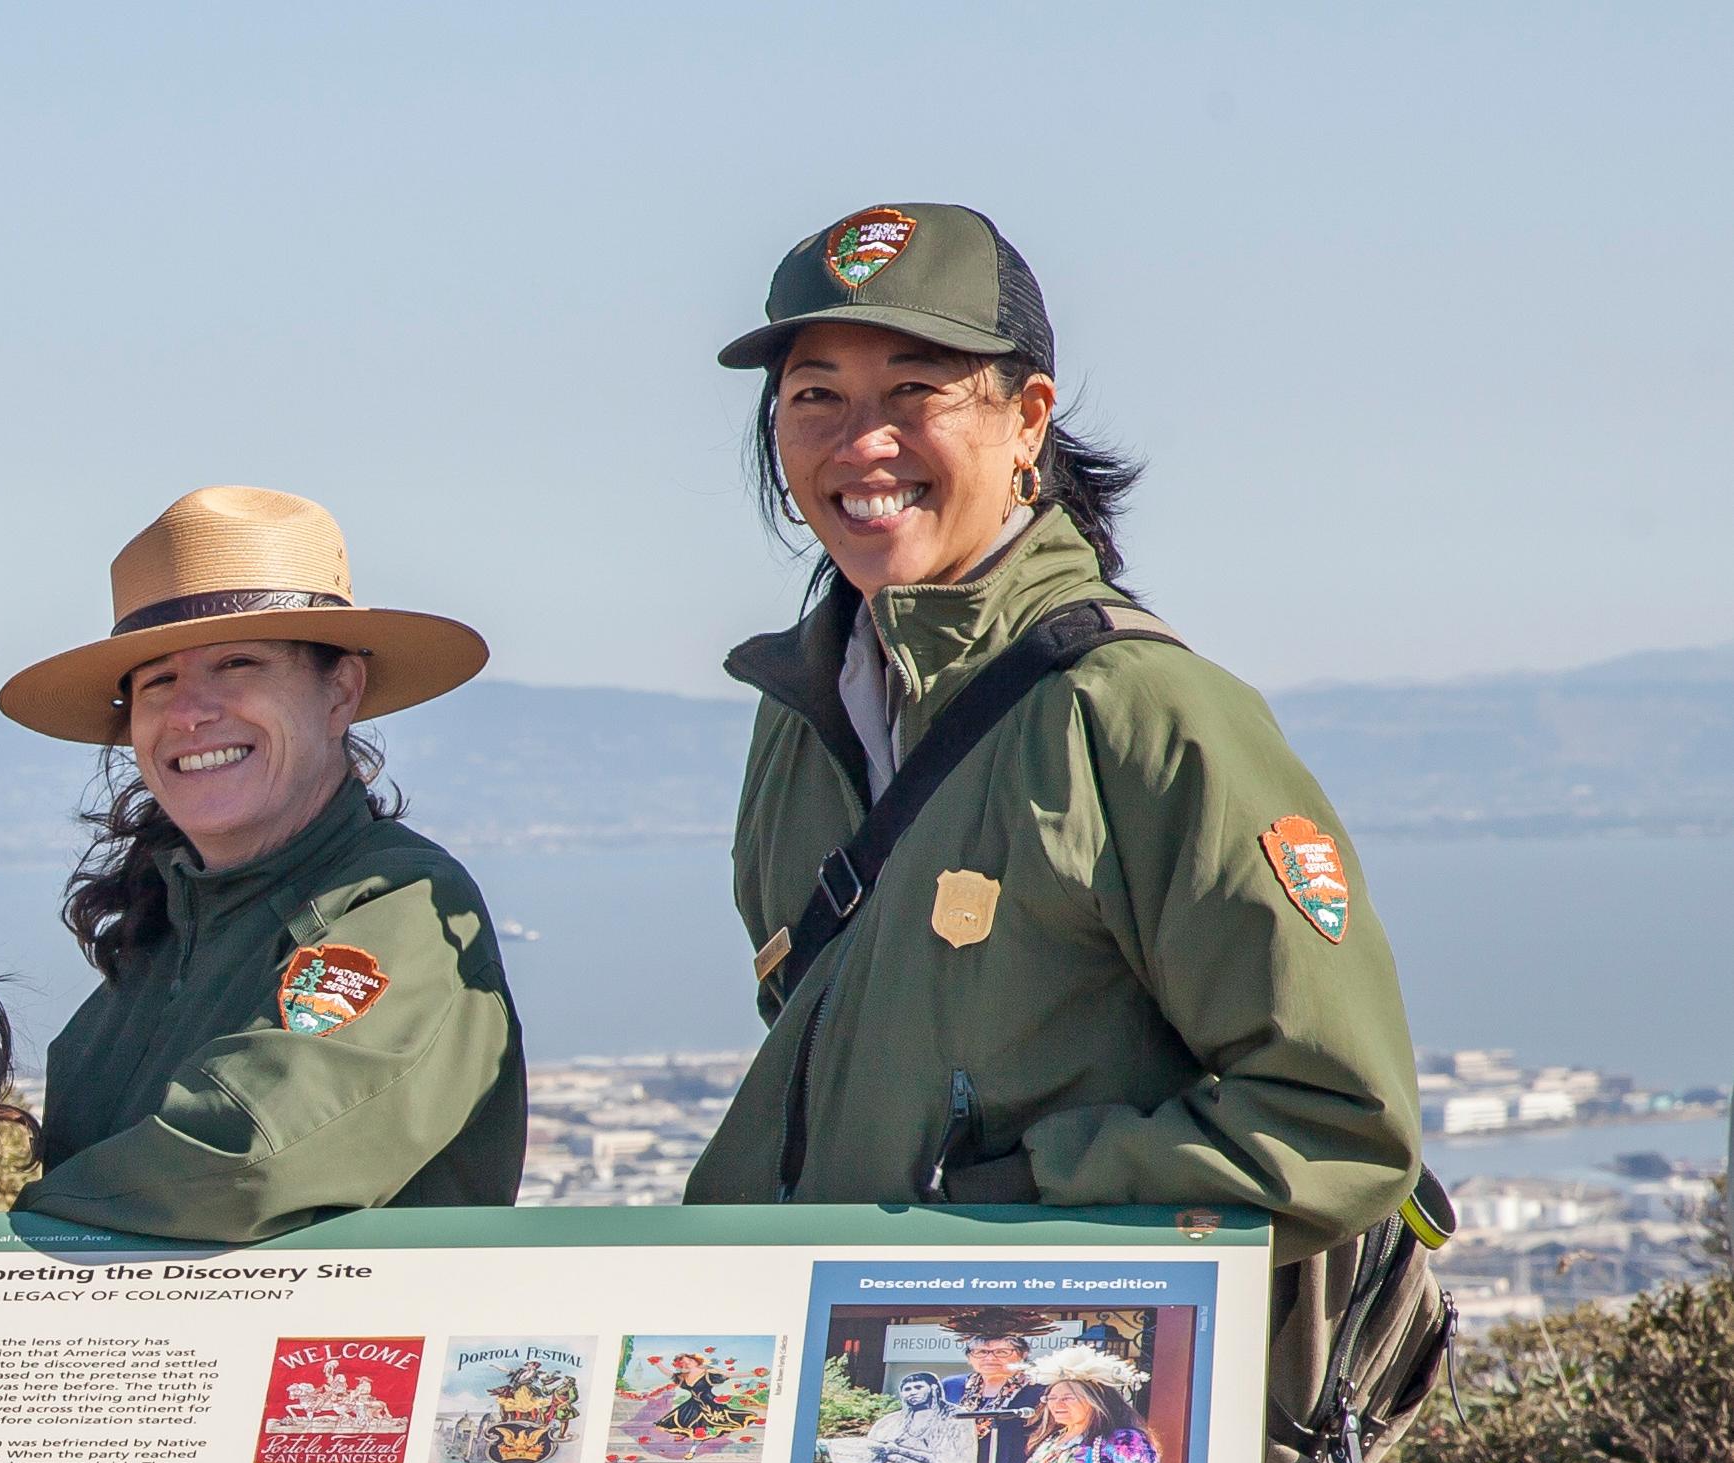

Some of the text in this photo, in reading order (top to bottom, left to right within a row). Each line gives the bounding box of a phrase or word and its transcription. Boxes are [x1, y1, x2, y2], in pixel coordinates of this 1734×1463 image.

[861, 223, 910, 231] NATIONAL
[860, 234, 905, 242] SERVICE
[1293, 843, 1333, 853] NATIONAL
[1304, 862, 1337, 873] SERVICE
[328, 966, 379, 988] NATIONAL
[335, 976, 363, 990] PARK
[323, 981, 367, 1000] SERVICE
[14, 1234, 78, 1242] Recreation
[104, 1265, 153, 1279] the
[163, 1264, 308, 1282] Discovery
[317, 1263, 372, 1278] Site
[859, 1277, 1167, 1291] Descended from the Expedition
[3, 1290, 85, 1301] LEGACY
[91, 1290, 118, 1300] OF
[125, 1289, 293, 1300] COLONIZATION?
[2, 1337, 26, 1346] the
[31, 1337, 61, 1346] lens
[66, 1337, 82, 1345] of
[87, 1337, 139, 1347] history
[144, 1337, 169, 1345] has
[893, 1337, 950, 1350] PRESIDIO
[1032, 1336, 1068, 1349] CLUB
[27, 1348, 58, 1357] that
[63, 1348, 126, 1357] America
[279, 1343, 419, 1370] WELCOME
[457, 1347, 584, 1371] PORTOLA FESTIVAL
[42, 1438, 128, 1447] befriended
[133, 1438, 152, 1448] by
[261, 1435, 406, 1453] Portola Festival
